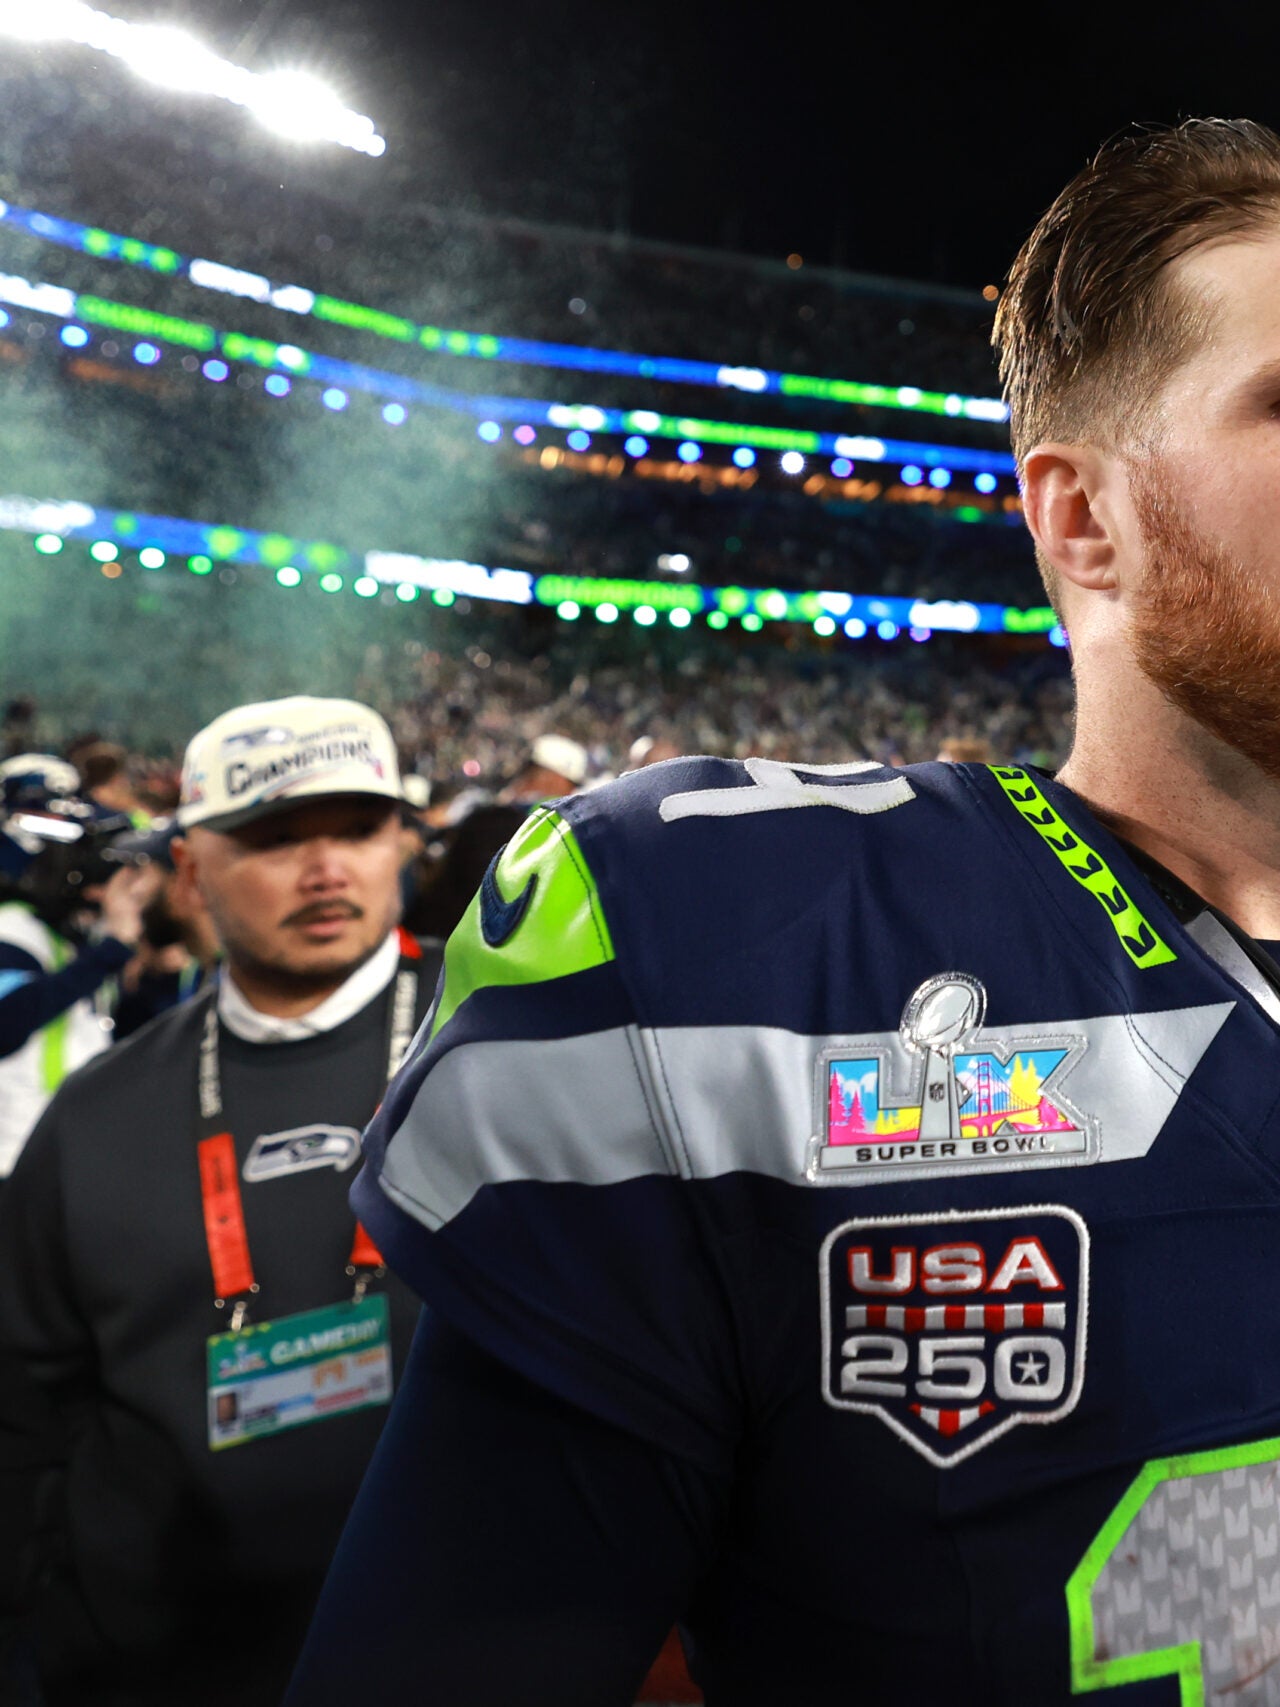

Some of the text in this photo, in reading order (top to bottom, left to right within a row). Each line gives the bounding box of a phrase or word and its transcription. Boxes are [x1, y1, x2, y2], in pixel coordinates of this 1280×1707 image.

[856, 1136, 1053, 1163] SUPER BOWL
[847, 1235, 1067, 1297] USA
[841, 1334, 1067, 1401] 250
